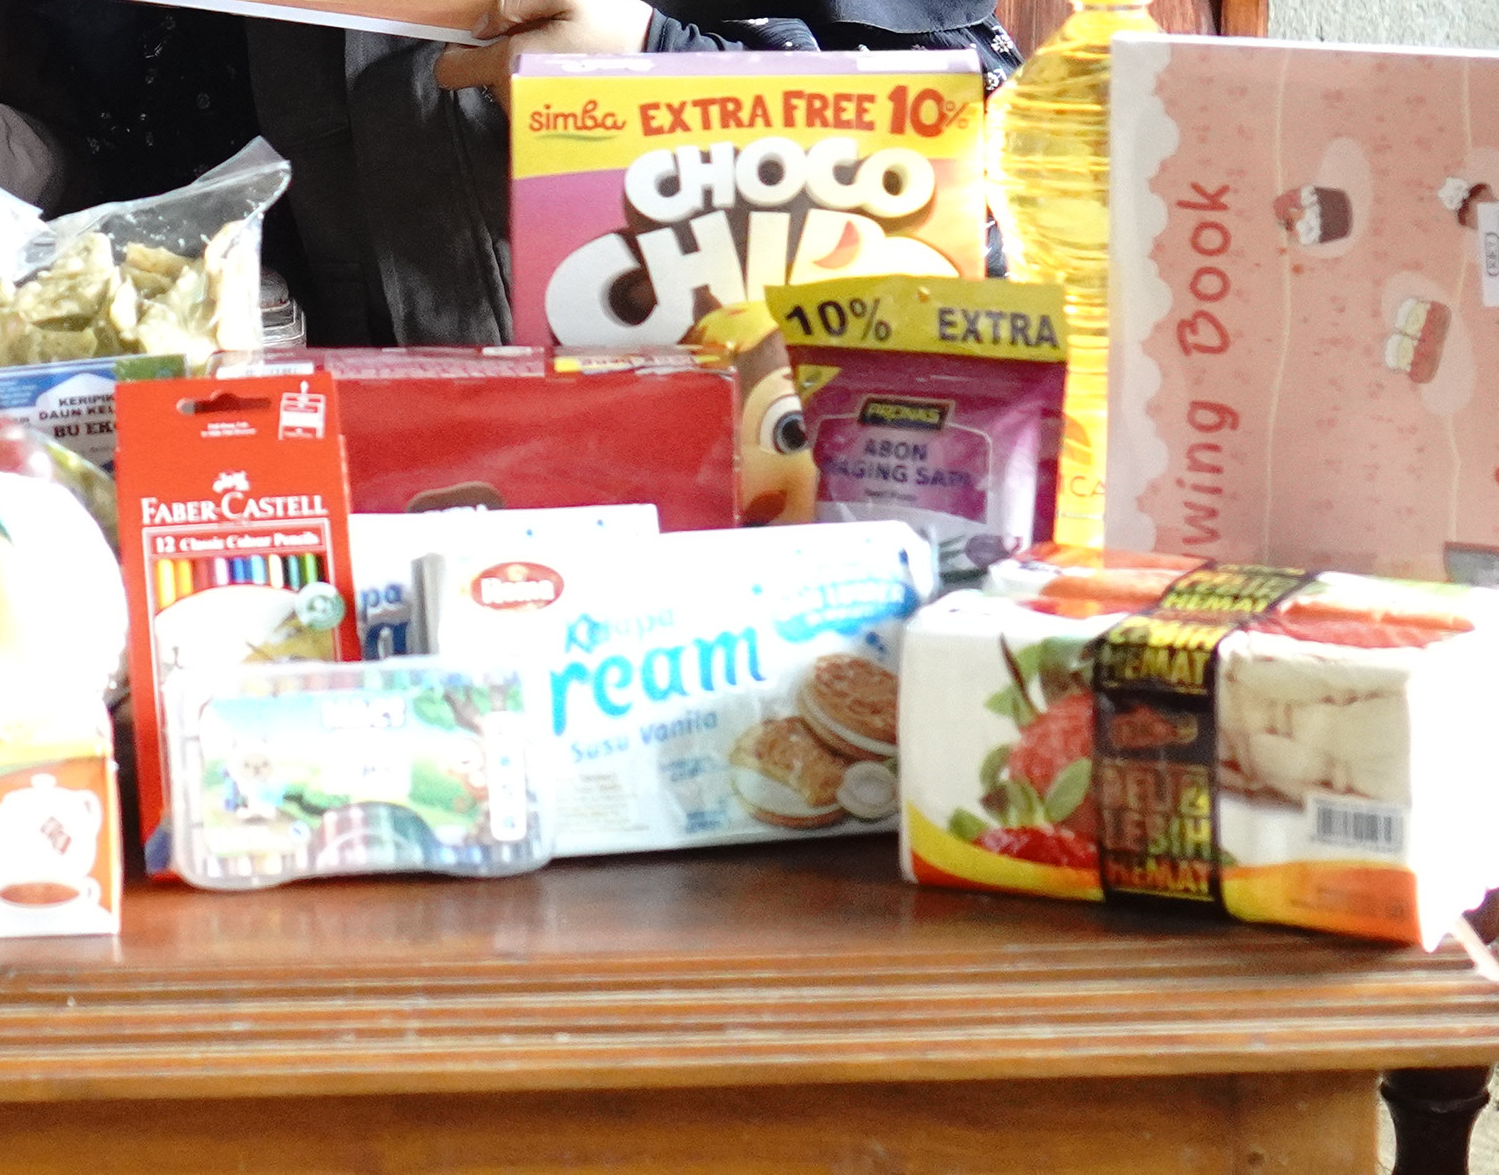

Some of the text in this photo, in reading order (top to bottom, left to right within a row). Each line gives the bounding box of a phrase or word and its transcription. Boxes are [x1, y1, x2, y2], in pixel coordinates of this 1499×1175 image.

[529, 85, 969, 137] simba EXTRA FREE 10%
[624, 137, 935, 223] CHOCO
[1177, 182, 1232, 357] Book
[786, 297, 1060, 350] 10% EXTRA
[39, 409, 81, 420] DAUN
[59, 394, 115, 407] KERIPIK
[54, 421, 115, 437] BU EK
[1176, 400, 1239, 558] wing
[156, 535, 175, 553] 12
[550, 627, 766, 737] ream
[571, 736, 629, 763] Susu
